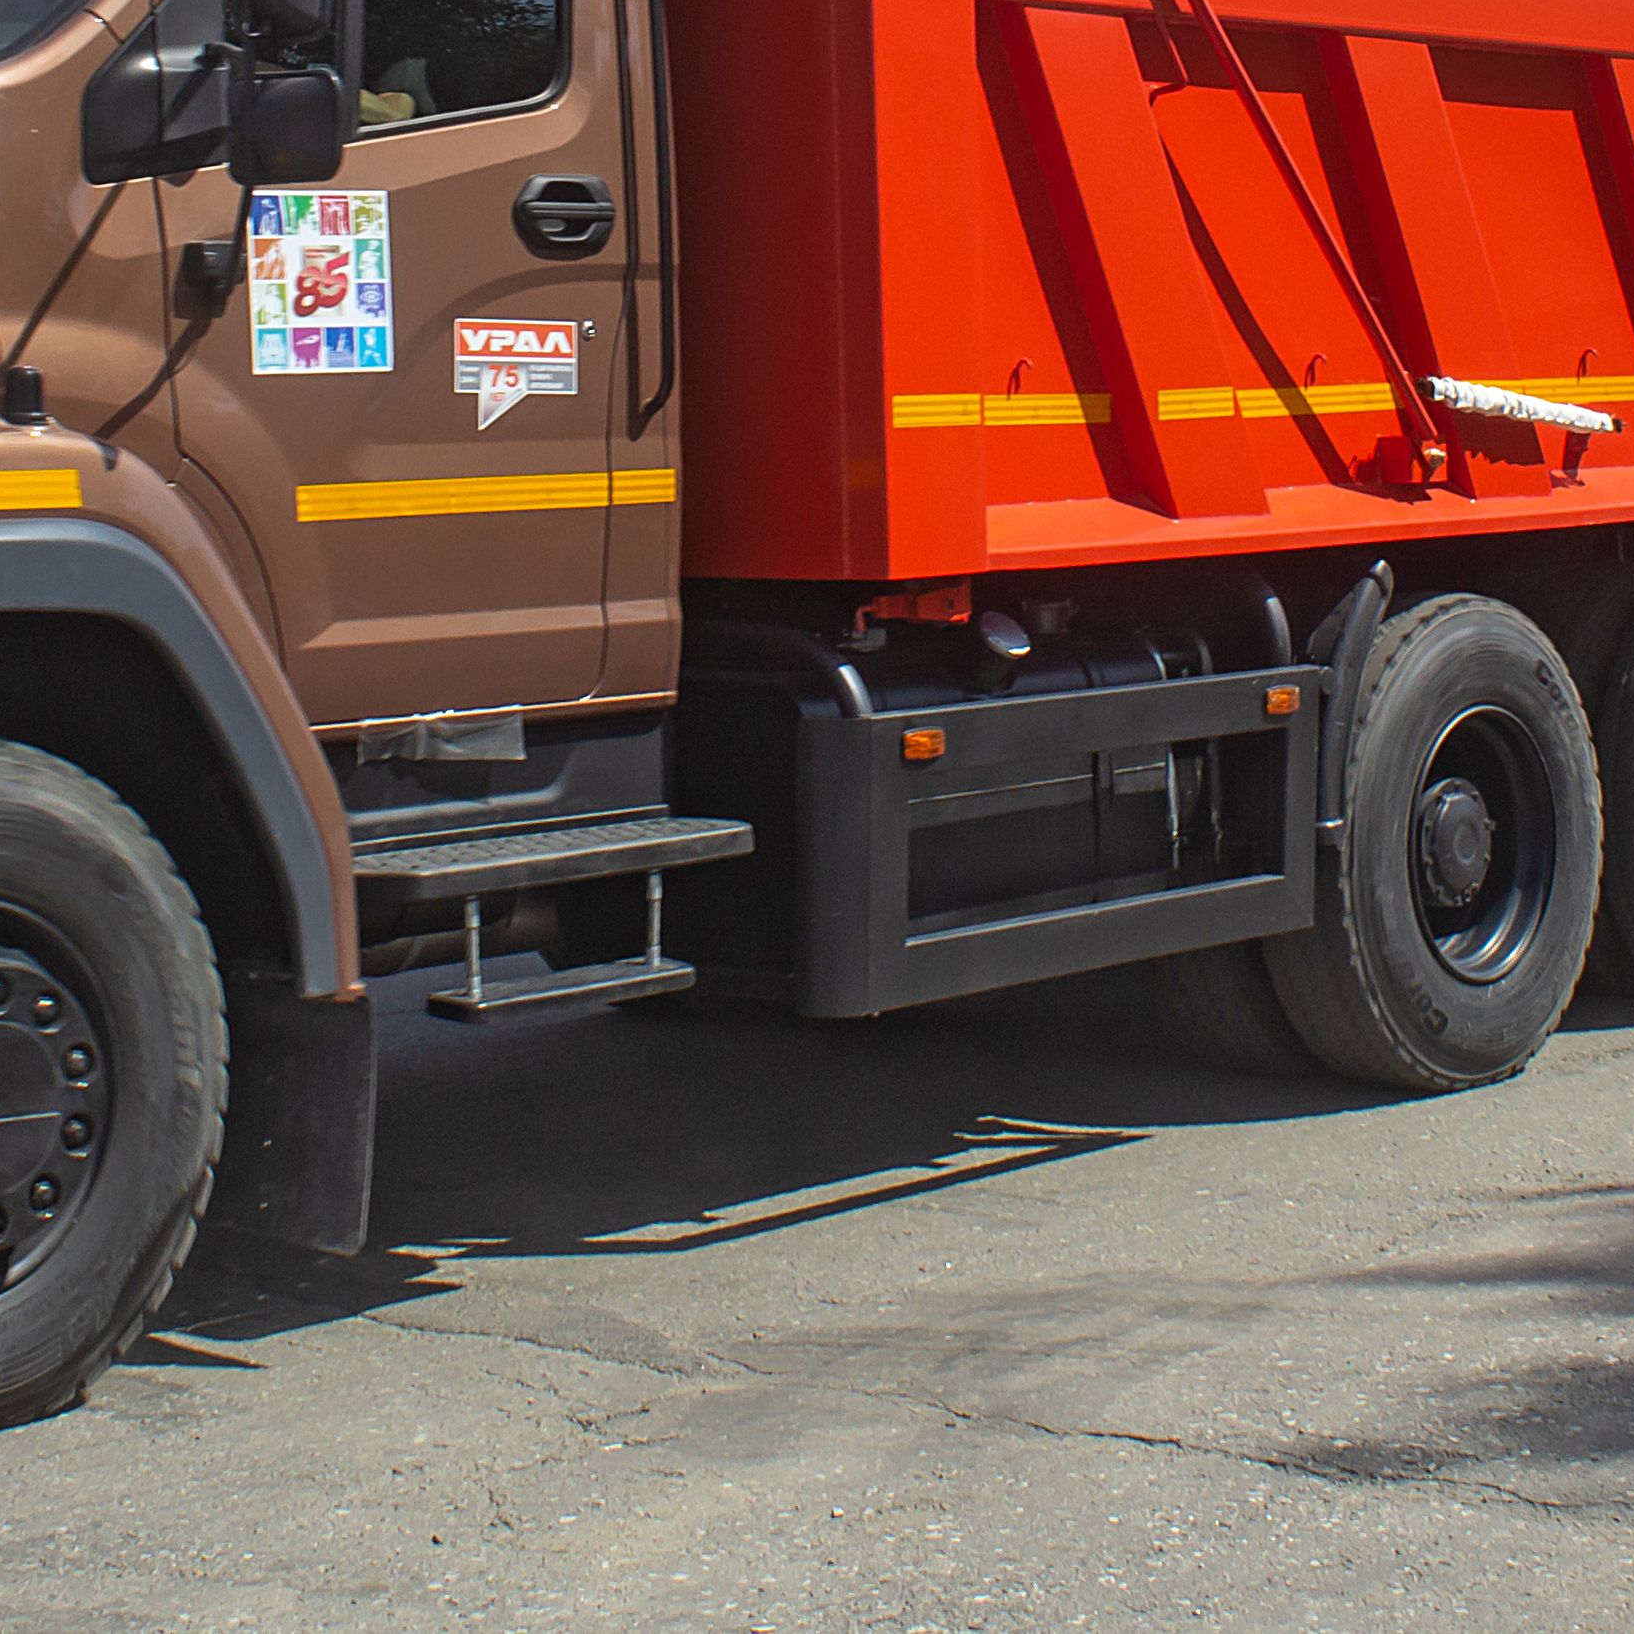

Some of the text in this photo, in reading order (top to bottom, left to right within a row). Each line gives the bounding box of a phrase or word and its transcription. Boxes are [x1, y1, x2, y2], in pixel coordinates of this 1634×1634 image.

[294, 251, 351, 317] 85
[461, 328, 572, 354] УРАЛ
[488, 364, 519, 388] 75
